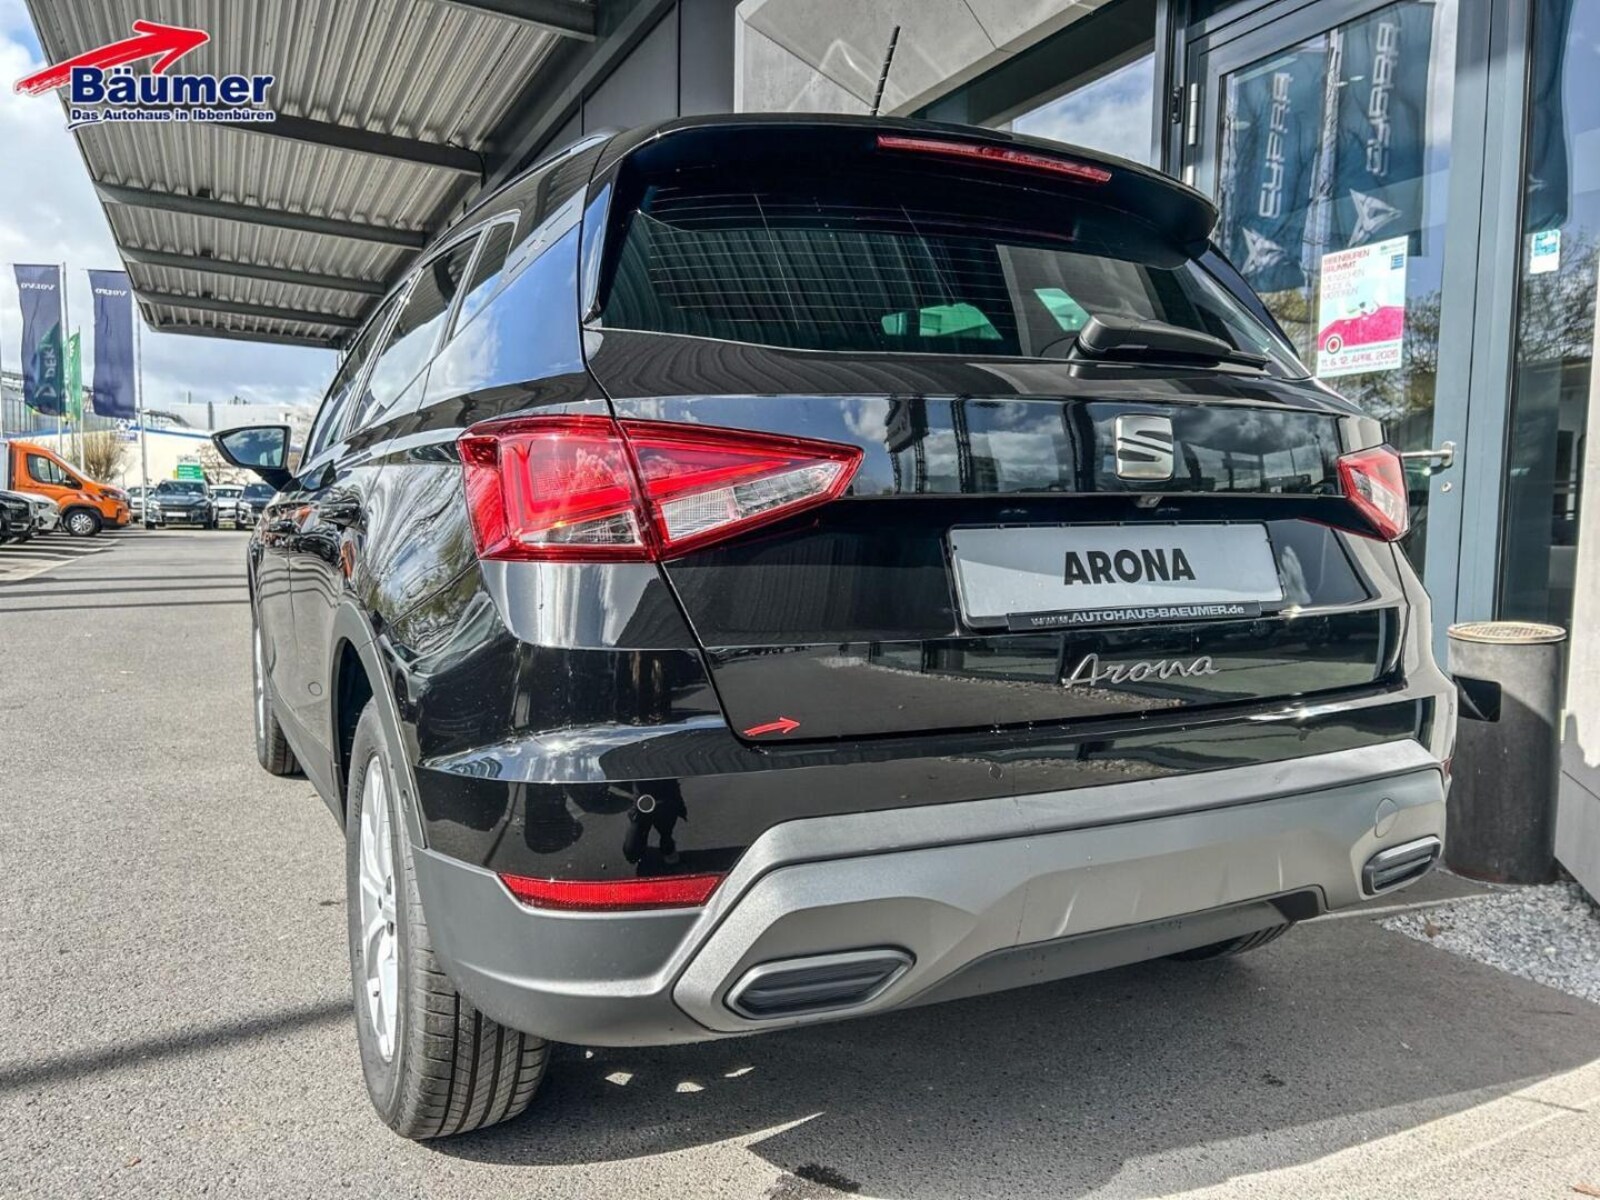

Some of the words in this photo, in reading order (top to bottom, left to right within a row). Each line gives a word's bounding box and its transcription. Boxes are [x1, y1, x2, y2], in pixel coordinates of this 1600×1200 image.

[1259, 73, 1294, 219] CUPRA
[1063, 548, 1196, 586] ARONA
[1030, 604, 1245, 627] www.AUTOHAUS-BAEUMER.de
[1060, 652, 1221, 688] Arona
